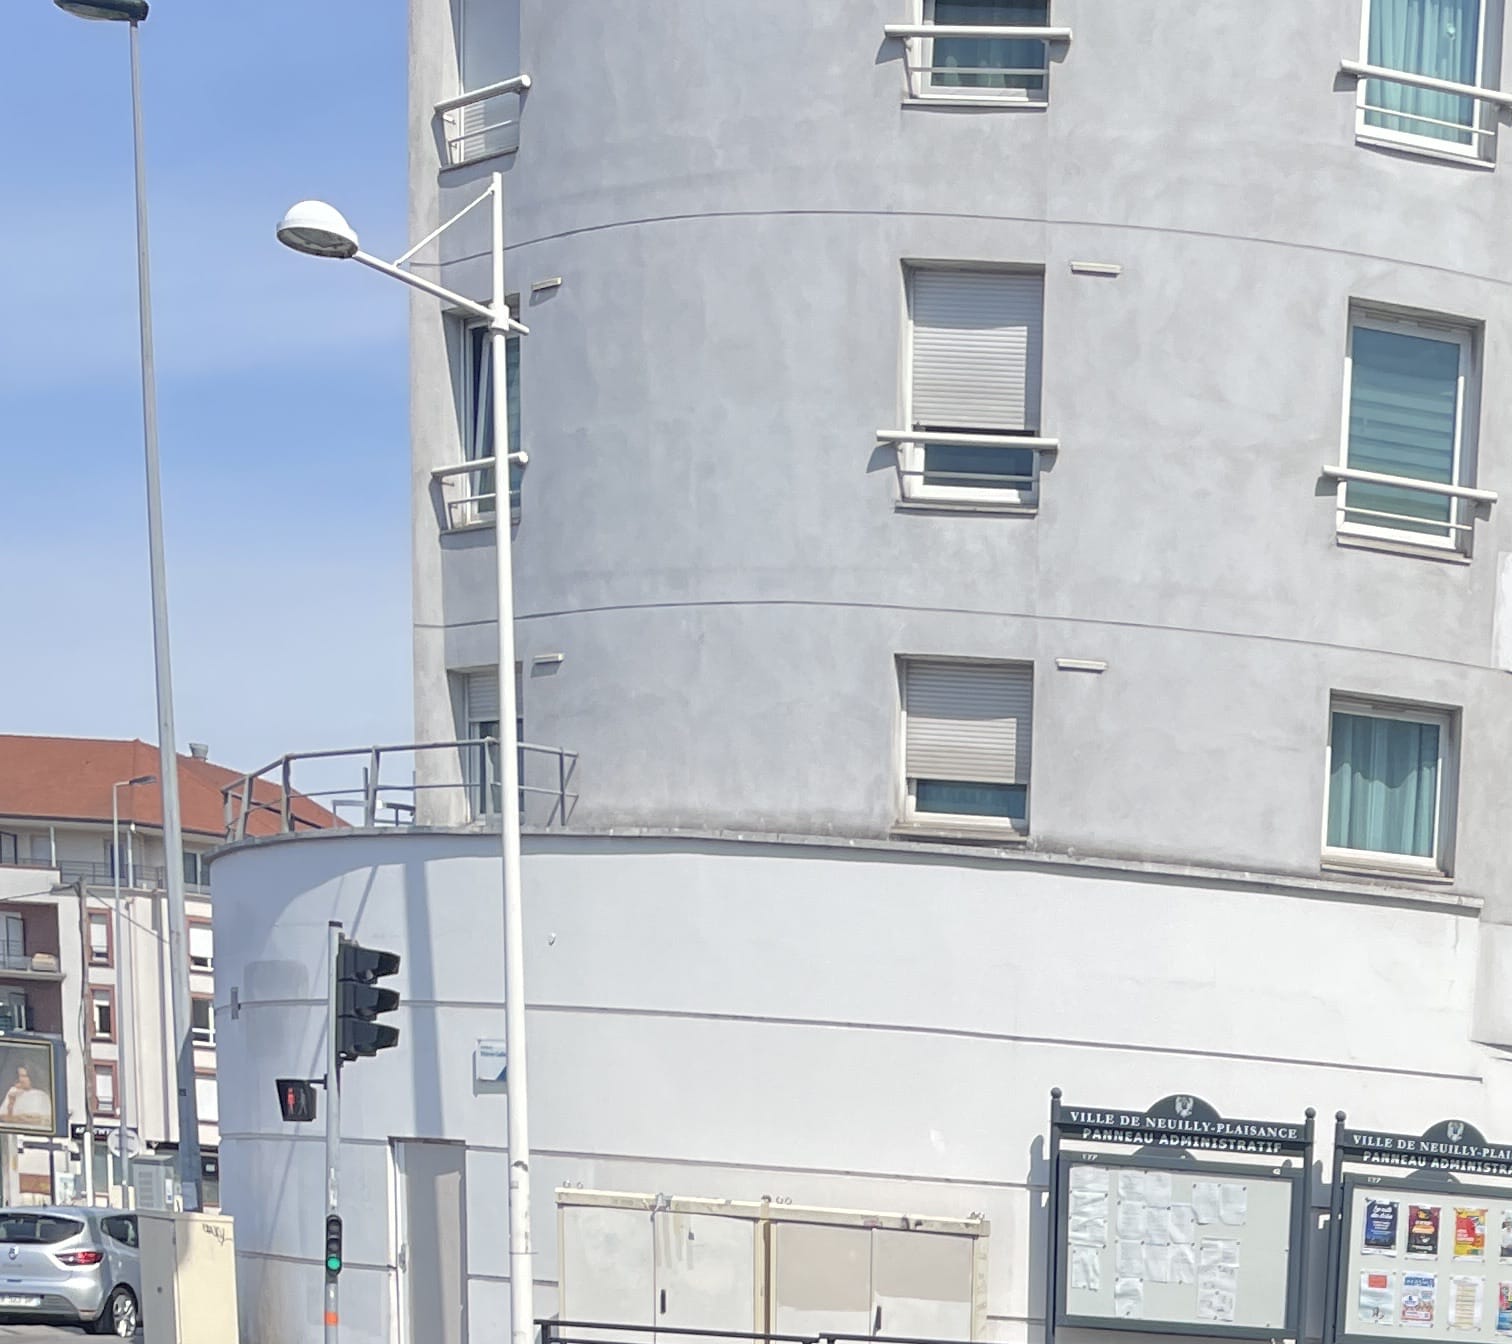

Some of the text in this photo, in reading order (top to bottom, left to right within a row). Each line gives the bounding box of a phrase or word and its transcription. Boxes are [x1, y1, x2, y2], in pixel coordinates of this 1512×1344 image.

[1070, 1111, 1298, 1139] VILLE DE NEUILLY-PLAISANCE
[1082, 1128, 1282, 1153] PANNEAU ADMINISTRATIF
[1353, 1134, 1393, 1148] VILLE
[1397, 1139, 1416, 1151] DE
[1363, 1151, 1427, 1167] PANNEAU
